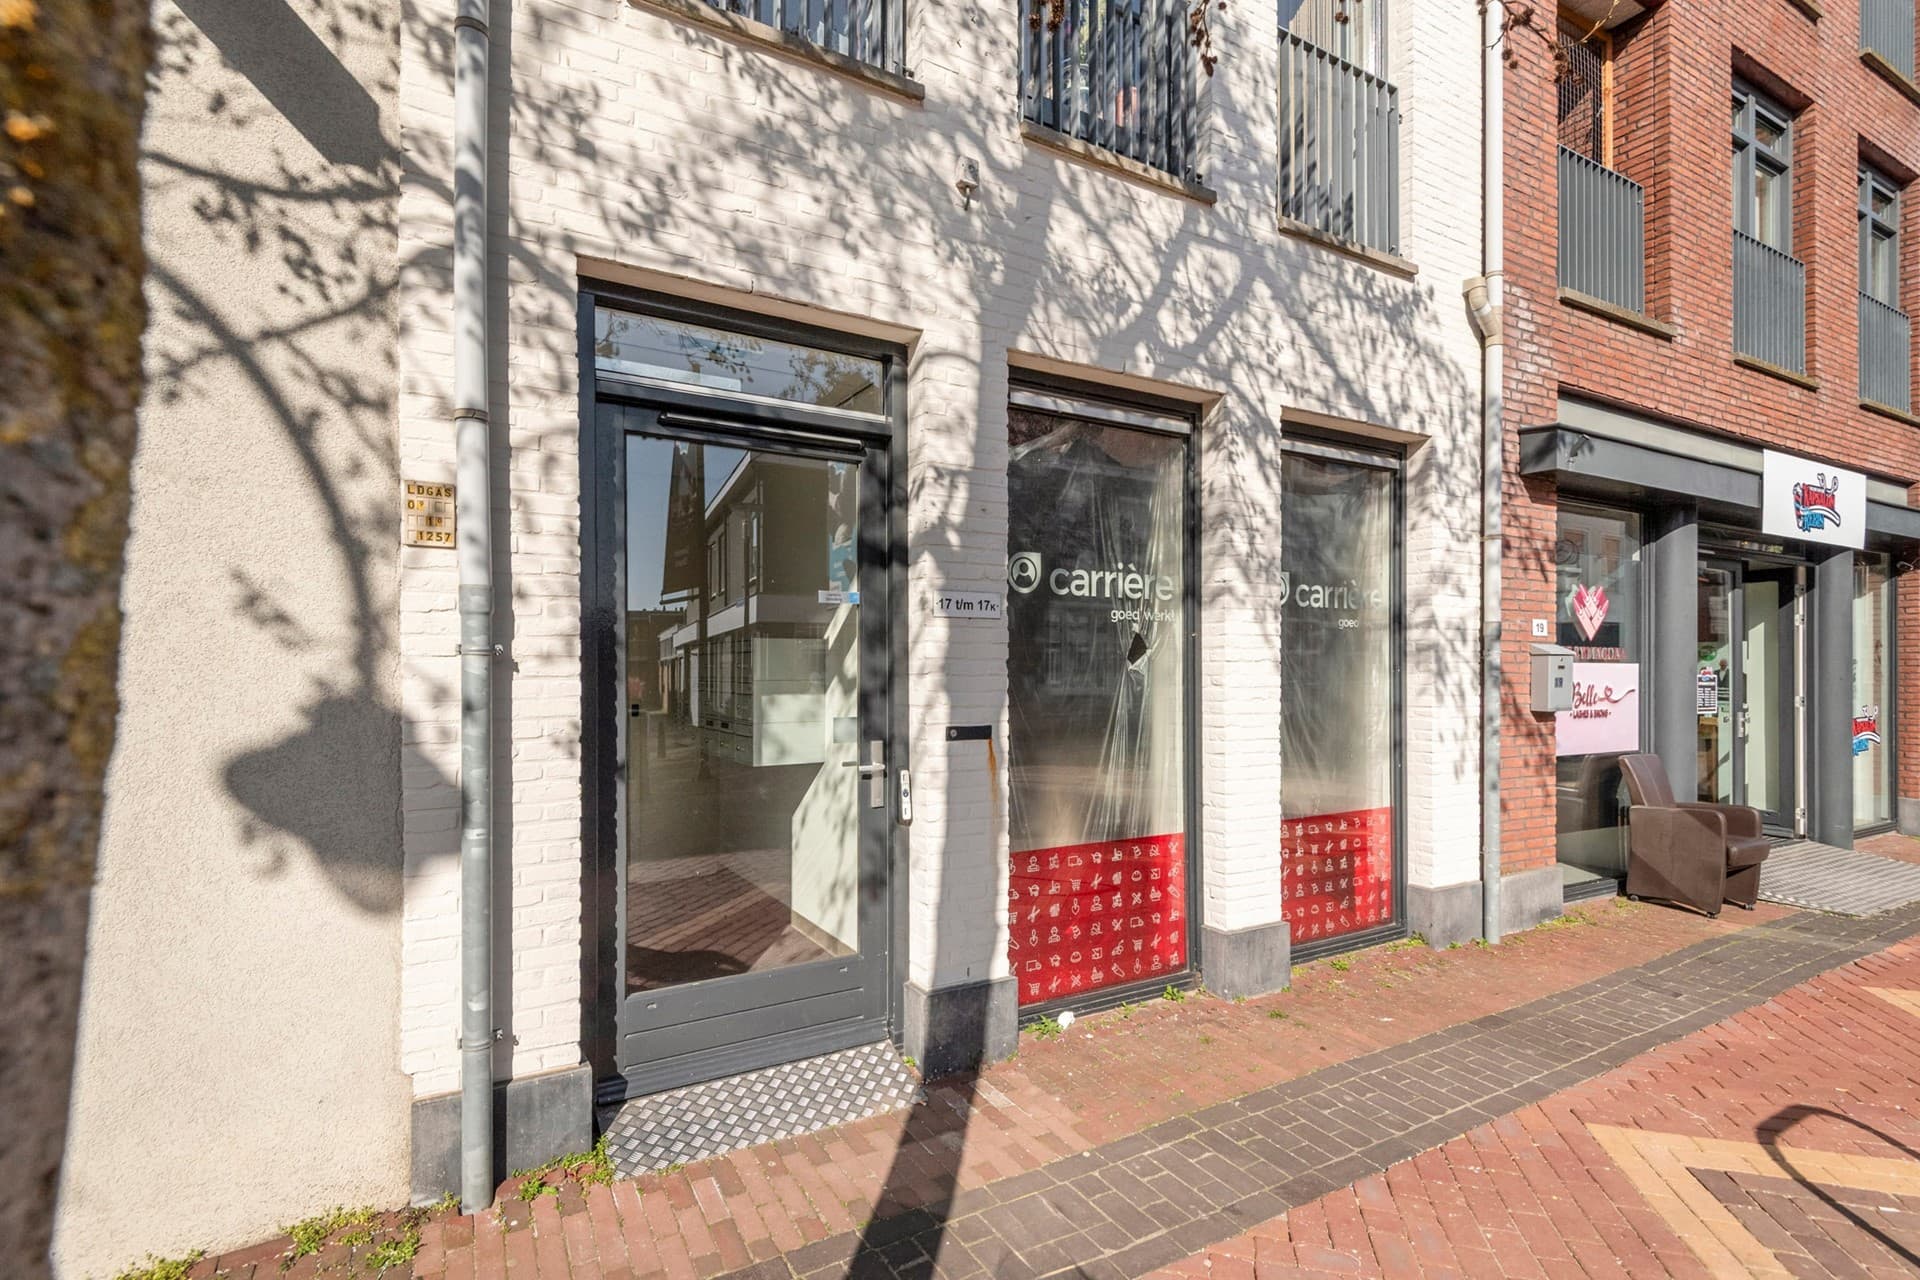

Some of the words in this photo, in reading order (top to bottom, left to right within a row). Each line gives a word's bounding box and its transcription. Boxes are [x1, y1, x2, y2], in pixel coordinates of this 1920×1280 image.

[418, 531, 452, 542] 1257
[1050, 562, 1174, 601] carrière
[938, 598, 953, 610] 17
[955, 598, 974, 611] t/m
[1110, 608, 1140, 623] goed
[1536, 623, 1544, 632] 19
